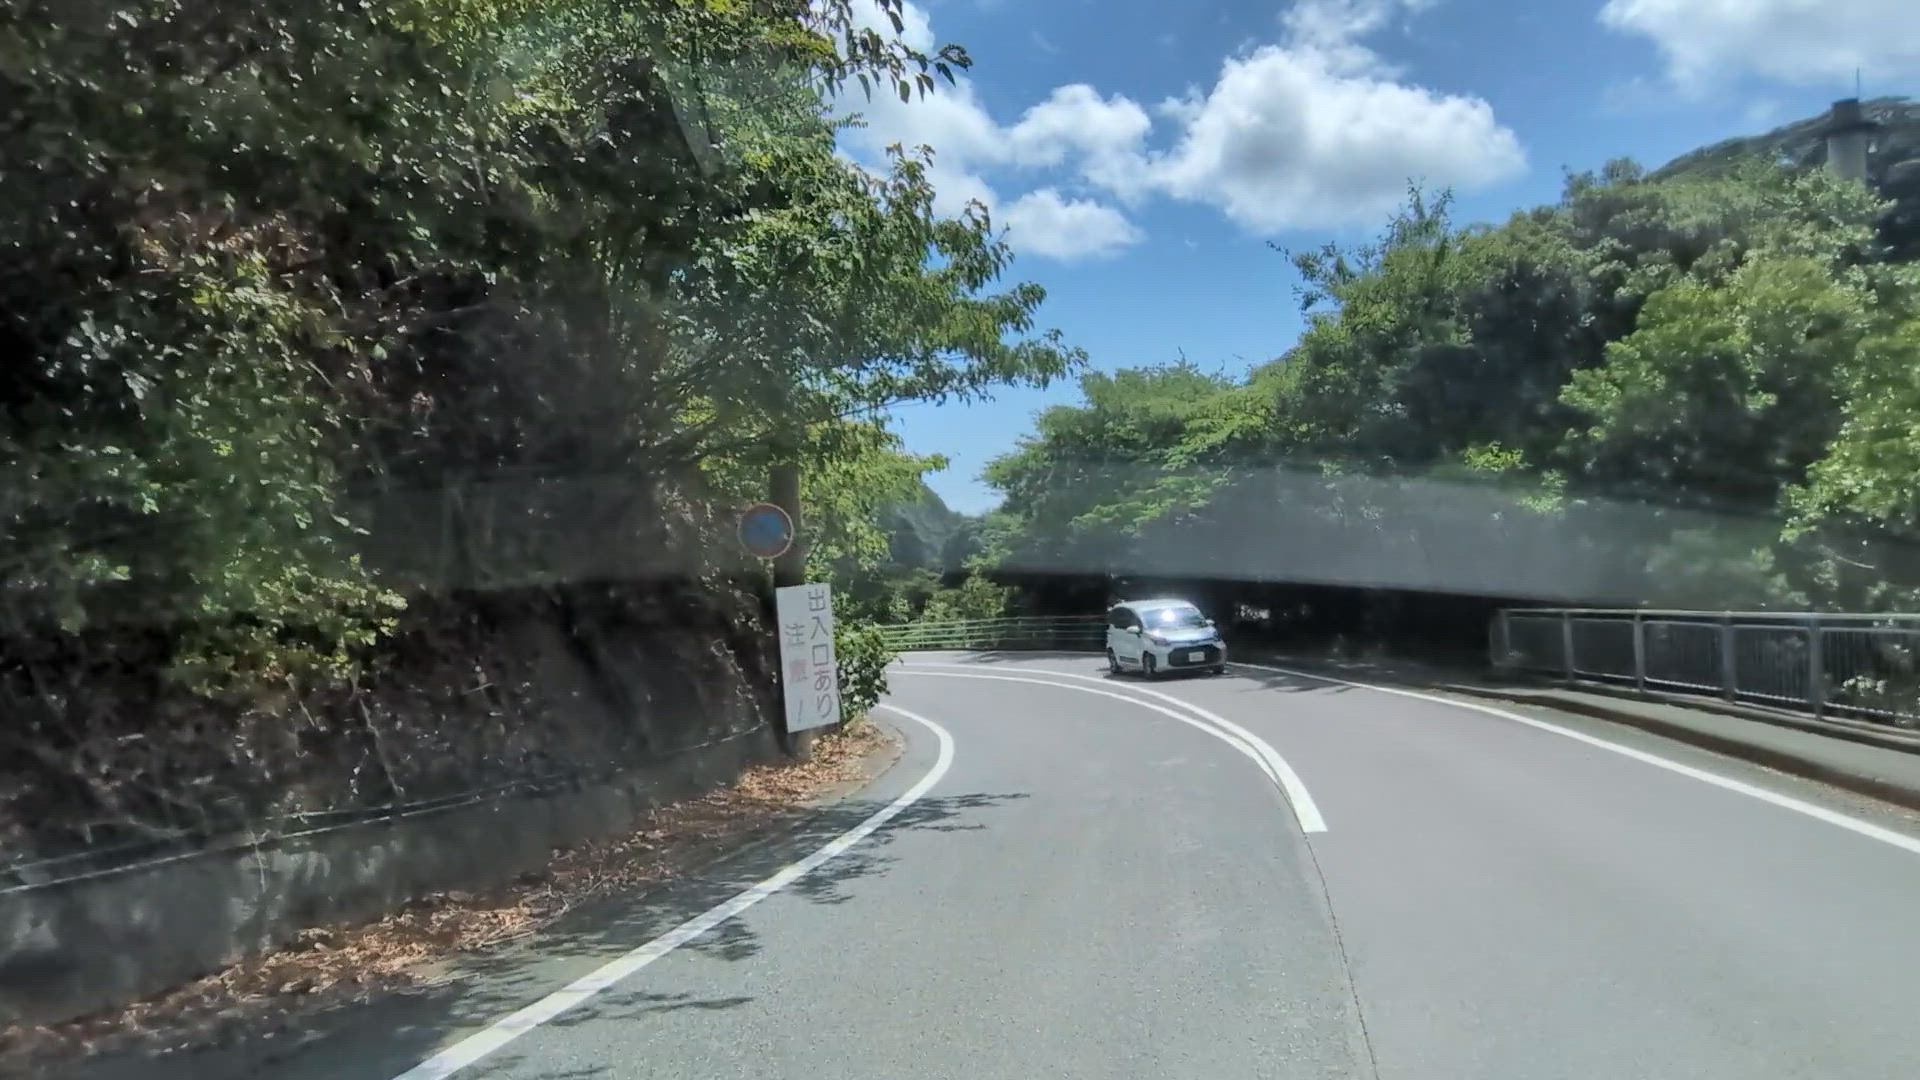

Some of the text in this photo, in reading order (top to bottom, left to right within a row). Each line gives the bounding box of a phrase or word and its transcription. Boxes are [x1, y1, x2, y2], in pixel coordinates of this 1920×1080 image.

[808, 588, 832, 718] 出入口あり
